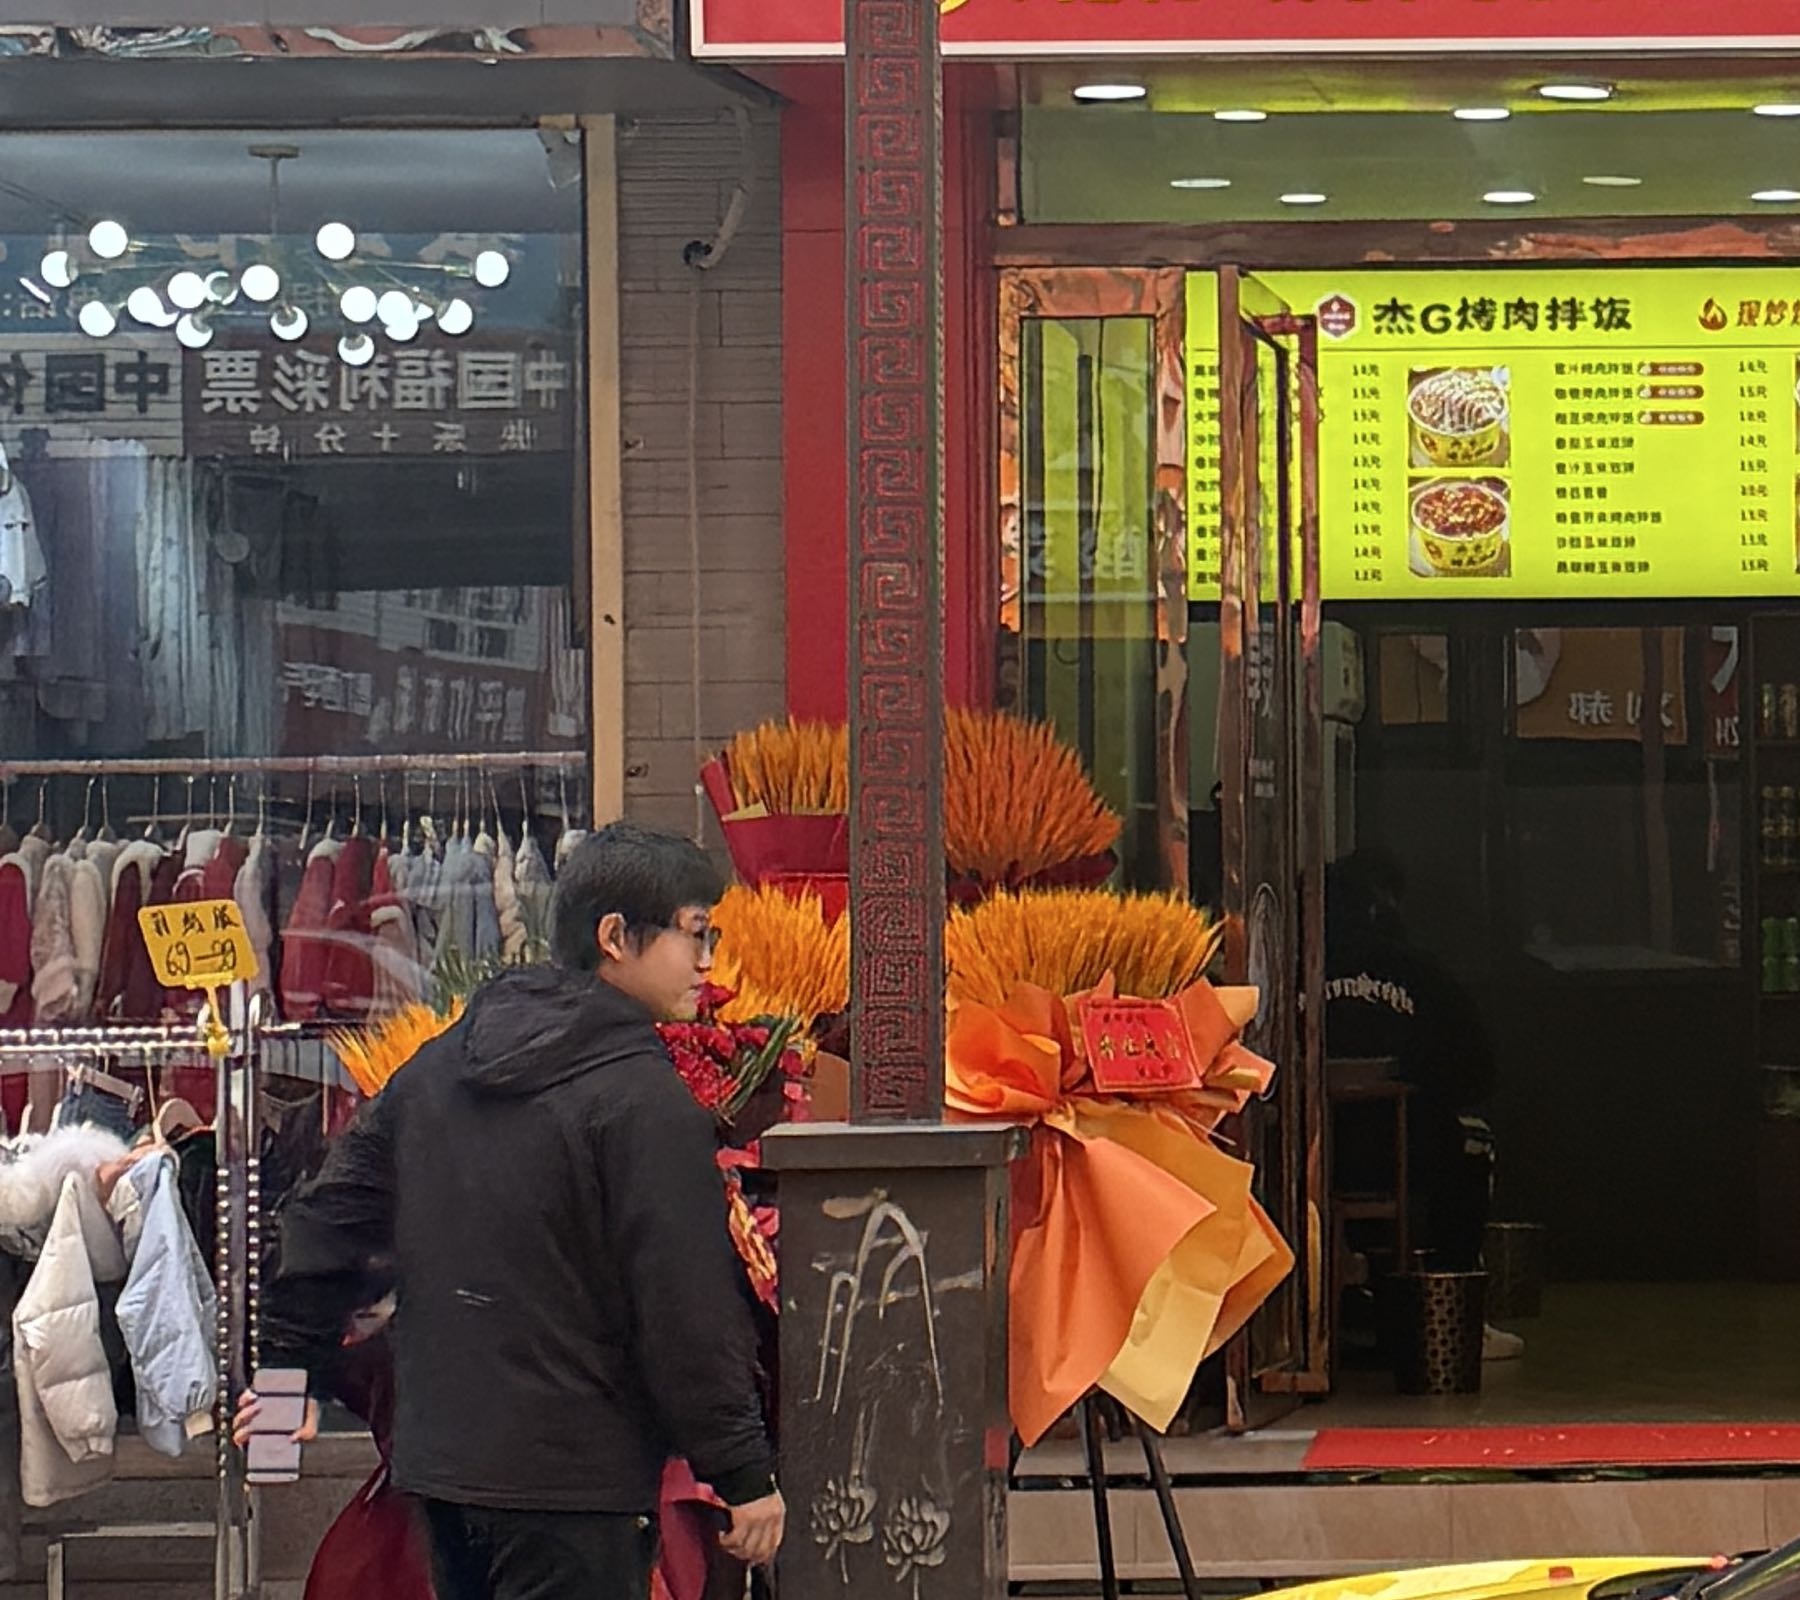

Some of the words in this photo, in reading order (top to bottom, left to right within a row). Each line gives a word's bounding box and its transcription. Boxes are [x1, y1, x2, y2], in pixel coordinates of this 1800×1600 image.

[1373, 296, 1632, 334] 杰G烤肉拌饭
